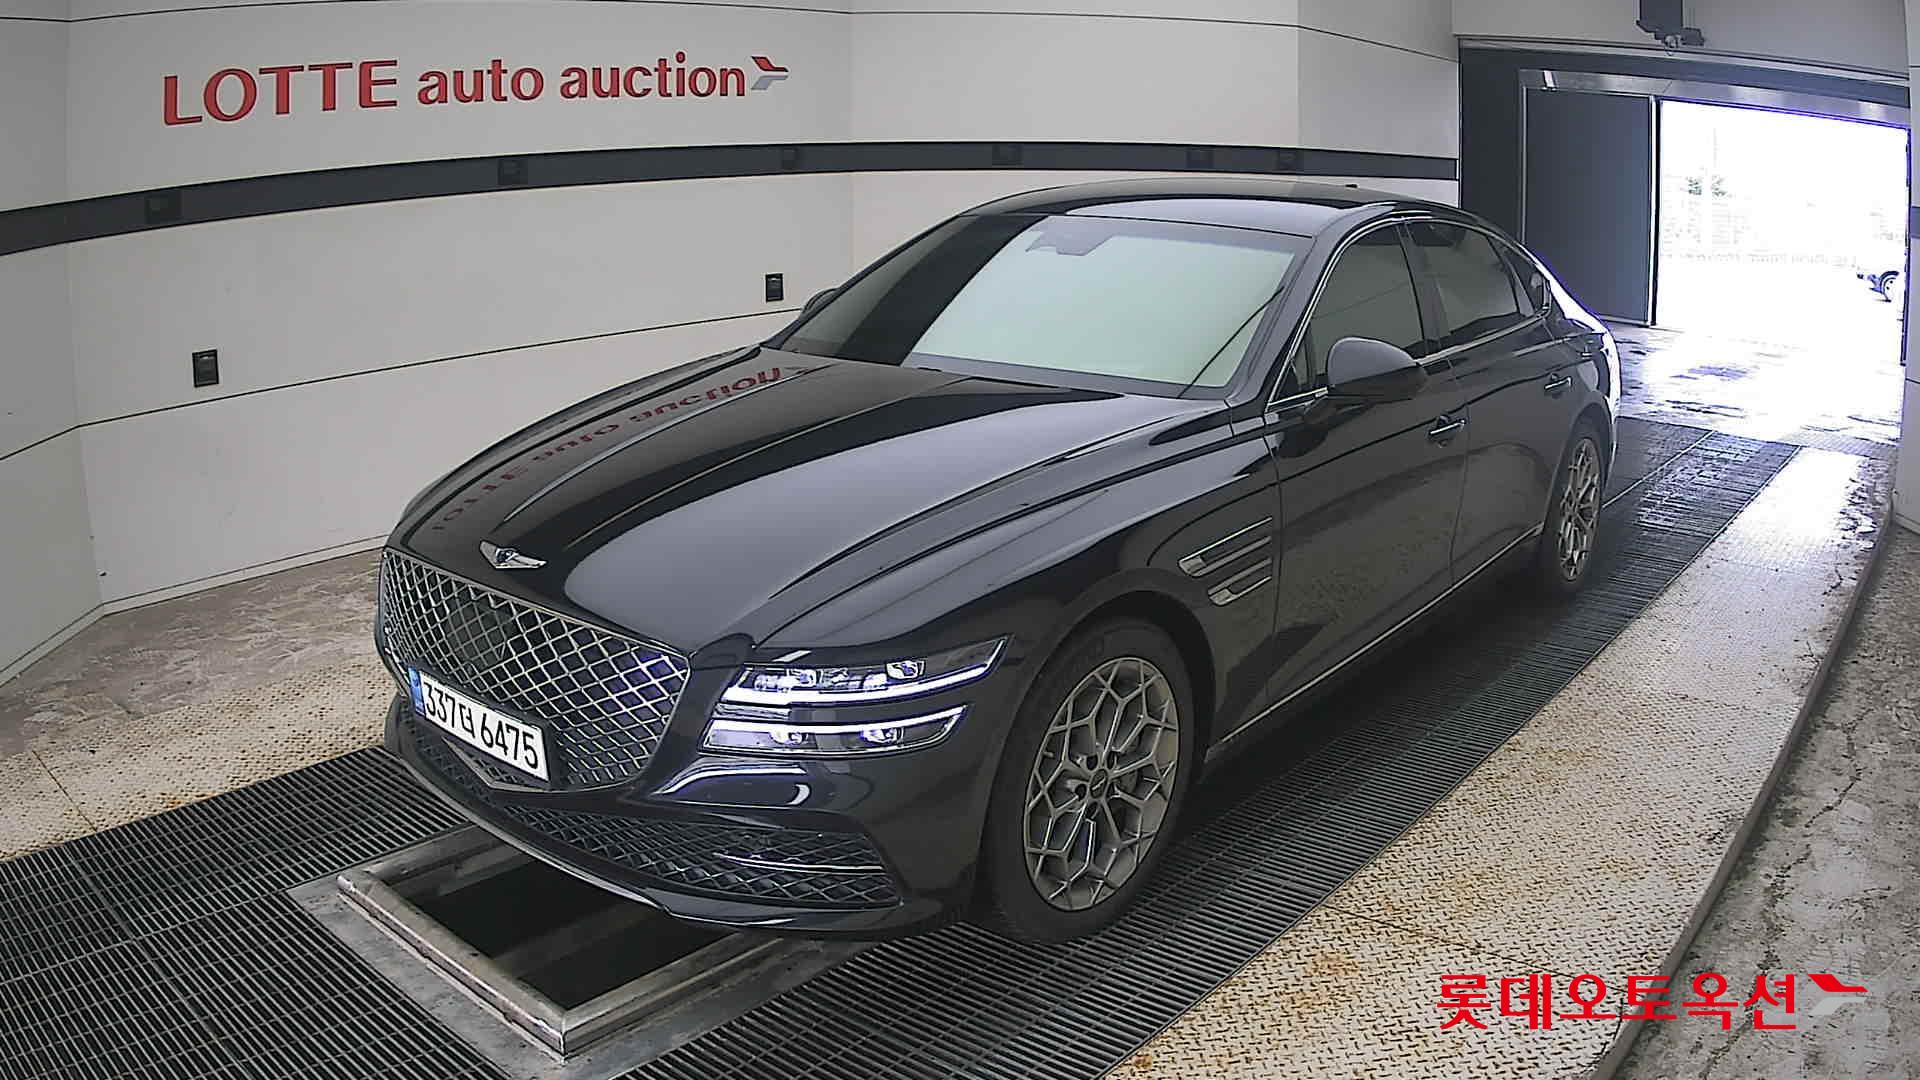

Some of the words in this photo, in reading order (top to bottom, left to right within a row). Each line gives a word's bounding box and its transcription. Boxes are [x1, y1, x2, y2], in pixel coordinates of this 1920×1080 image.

[163, 59, 398, 126] LOTTE
[417, 58, 544, 105] auto
[559, 51, 747, 99] auction
[423, 682, 476, 739] 337더
[480, 712, 539, 770] 6475
